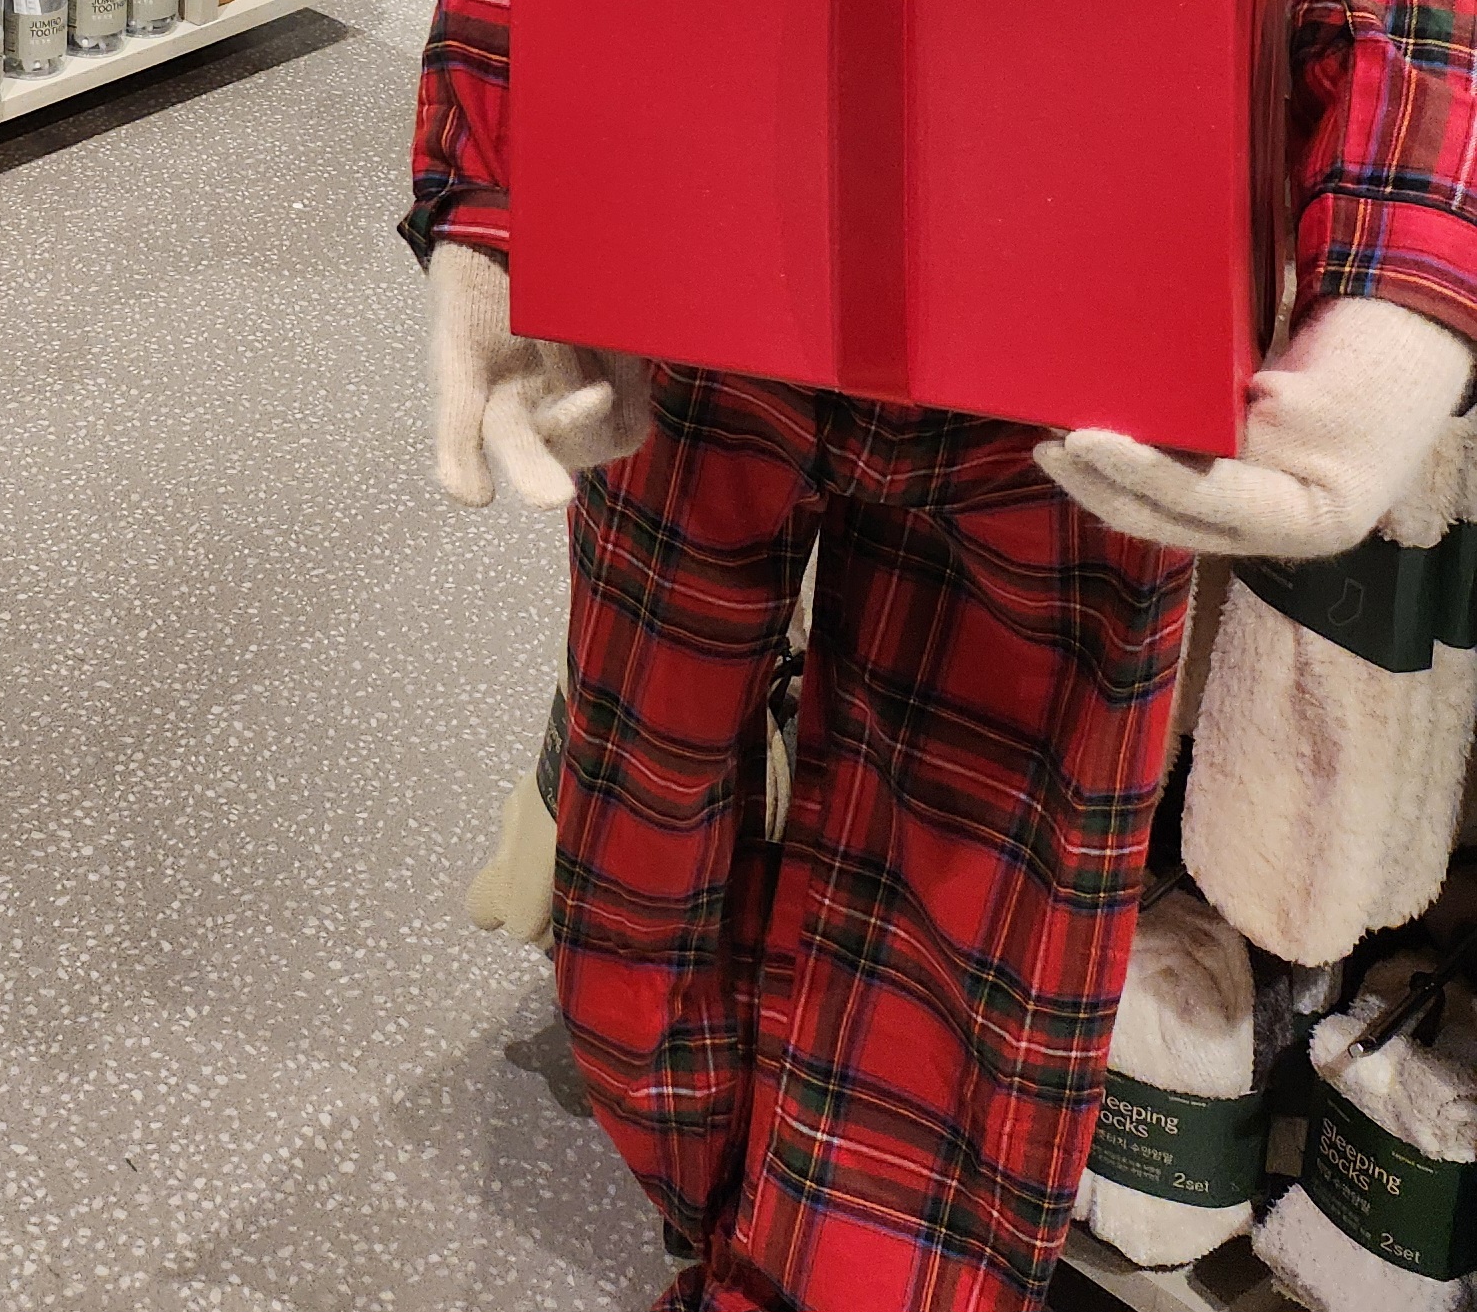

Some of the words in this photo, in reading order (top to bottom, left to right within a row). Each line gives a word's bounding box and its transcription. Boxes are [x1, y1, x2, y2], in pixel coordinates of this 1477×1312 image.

[29, 17, 62, 29] JUMBO
[1100, 1110, 1148, 1138] ocks
[1101, 1089, 1179, 1135] leeping
[1320, 1135, 1370, 1190] Socks
[1323, 1118, 1401, 1196] Sleeping
[1173, 1173, 1209, 1192] 2set
[1380, 1233, 1421, 1263] 2set
